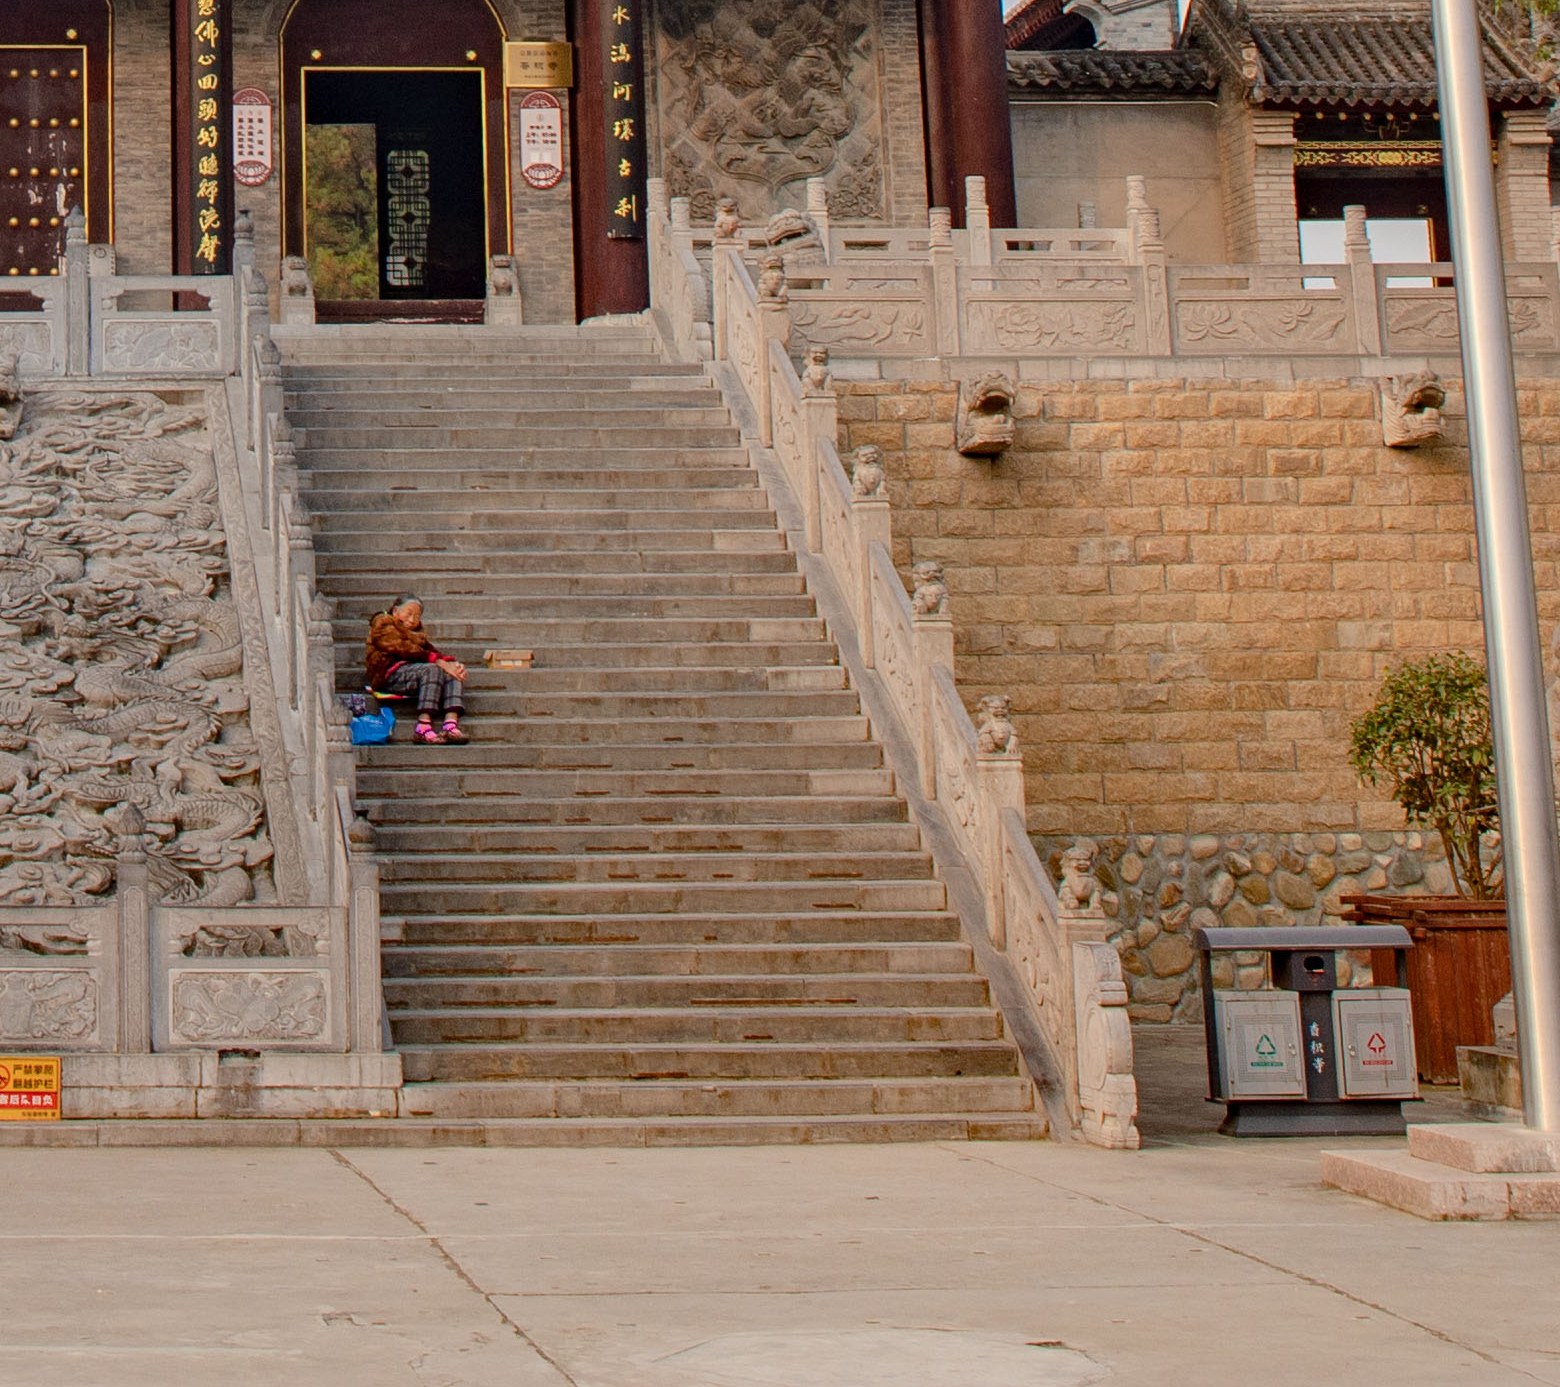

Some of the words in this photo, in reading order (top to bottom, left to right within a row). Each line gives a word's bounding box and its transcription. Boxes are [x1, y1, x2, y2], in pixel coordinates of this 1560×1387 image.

[13, 1064, 54, 1075] 严禁攀爬
[13, 1078, 54, 1089] 翻越护栏
